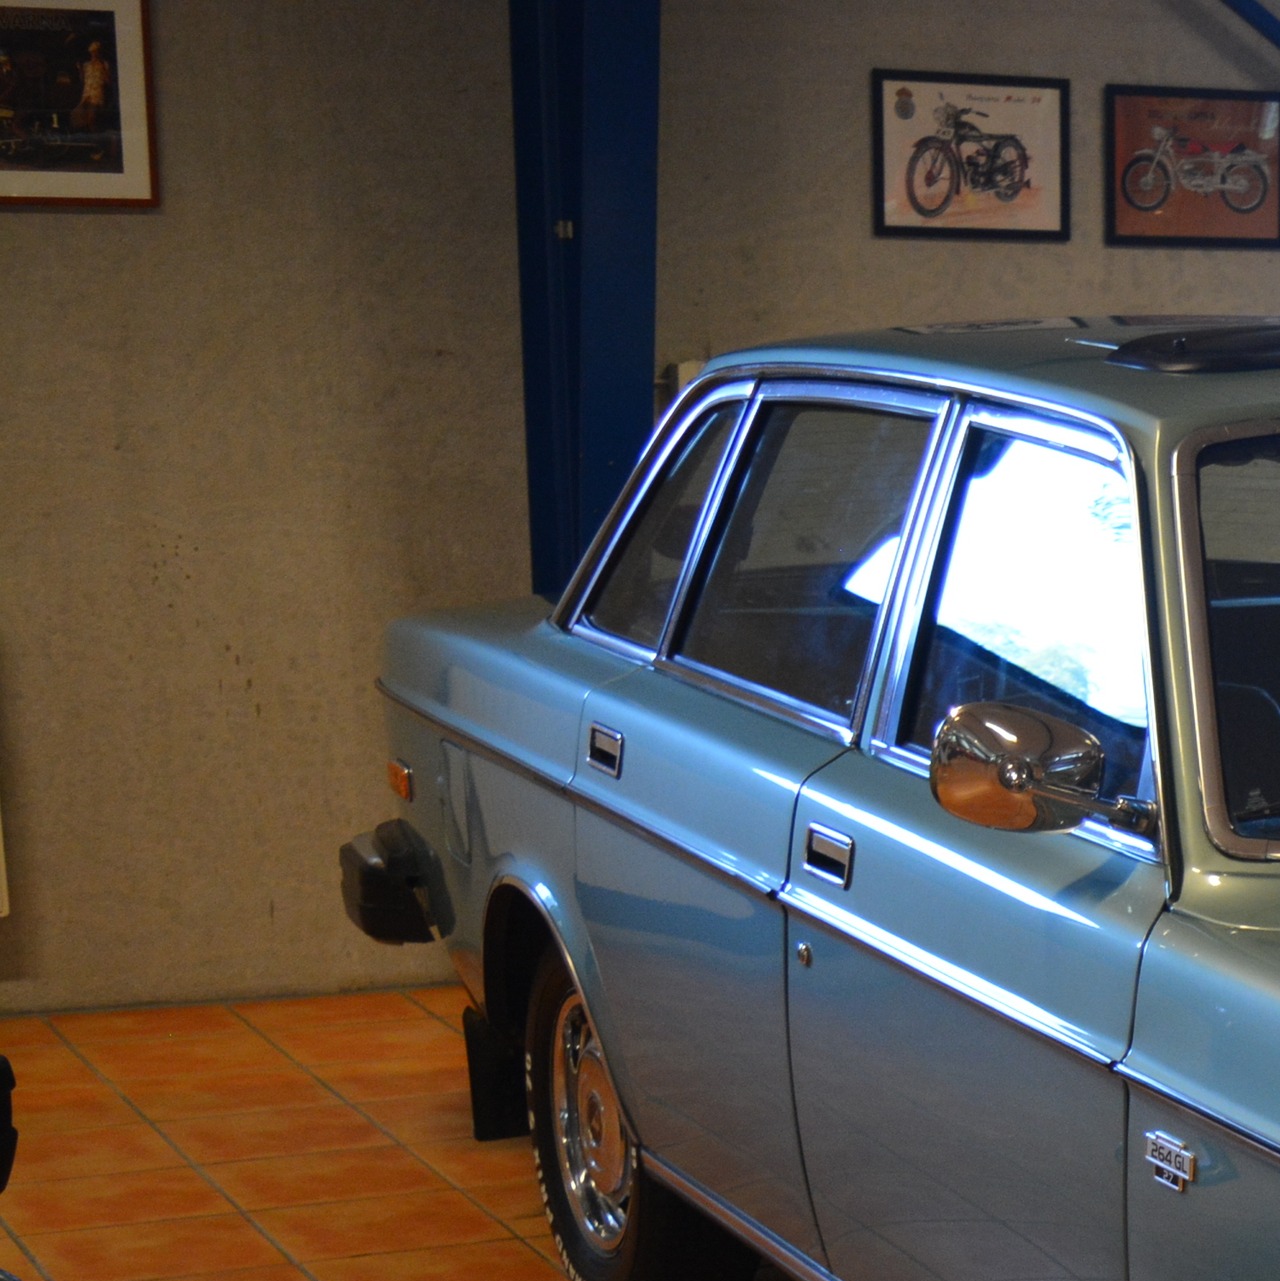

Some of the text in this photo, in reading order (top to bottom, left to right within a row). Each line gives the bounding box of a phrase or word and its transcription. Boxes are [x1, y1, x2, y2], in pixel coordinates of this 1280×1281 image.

[1151, 1142, 1188, 1174] 264 GL
[1163, 1170, 1174, 1183] 27
